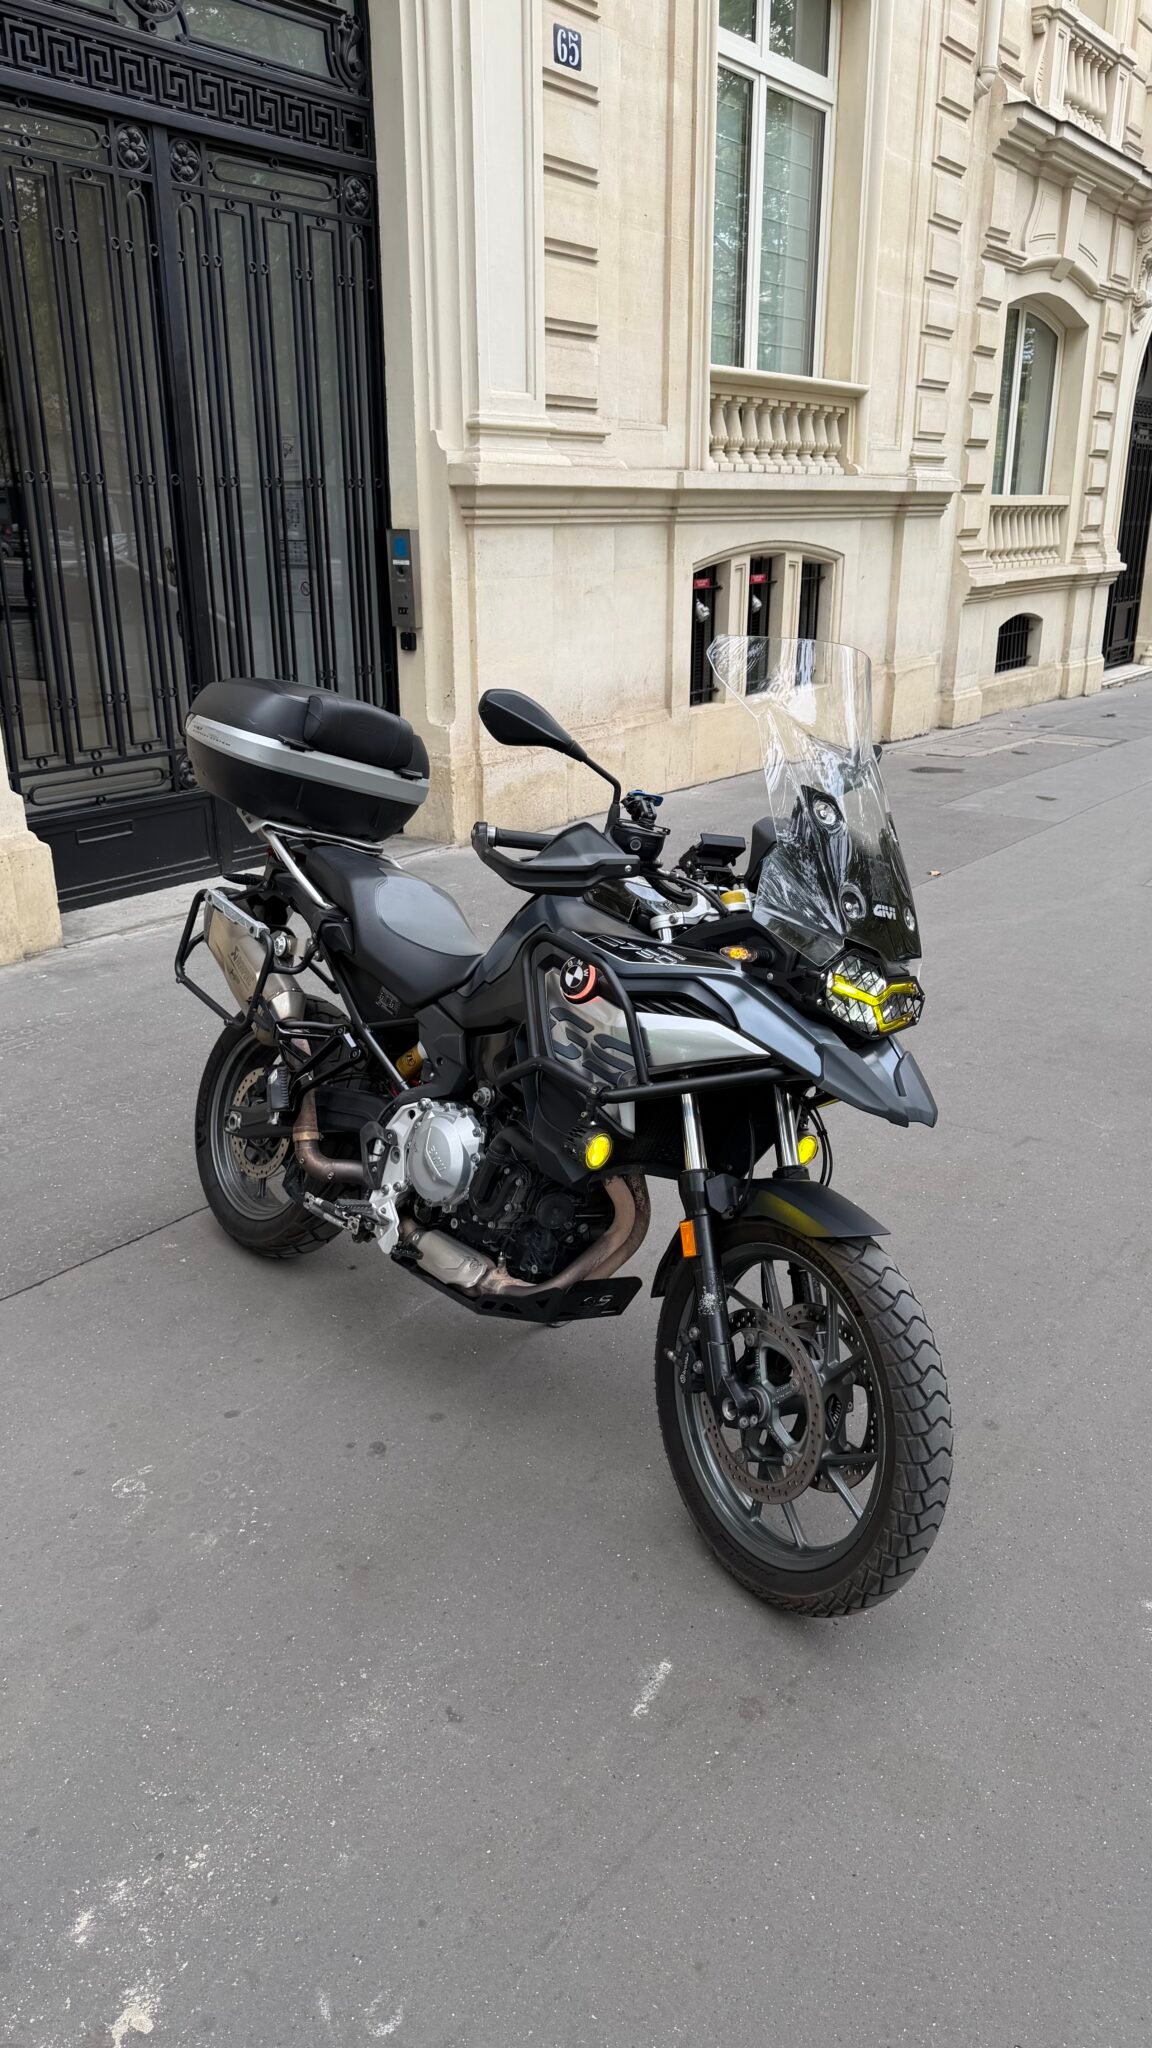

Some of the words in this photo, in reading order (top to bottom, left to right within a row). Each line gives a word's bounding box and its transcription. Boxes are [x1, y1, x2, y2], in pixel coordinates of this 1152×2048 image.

[557, 29, 580, 66] 65
[873, 904, 897, 920] GIVI
[567, 959, 589, 977] BMW
